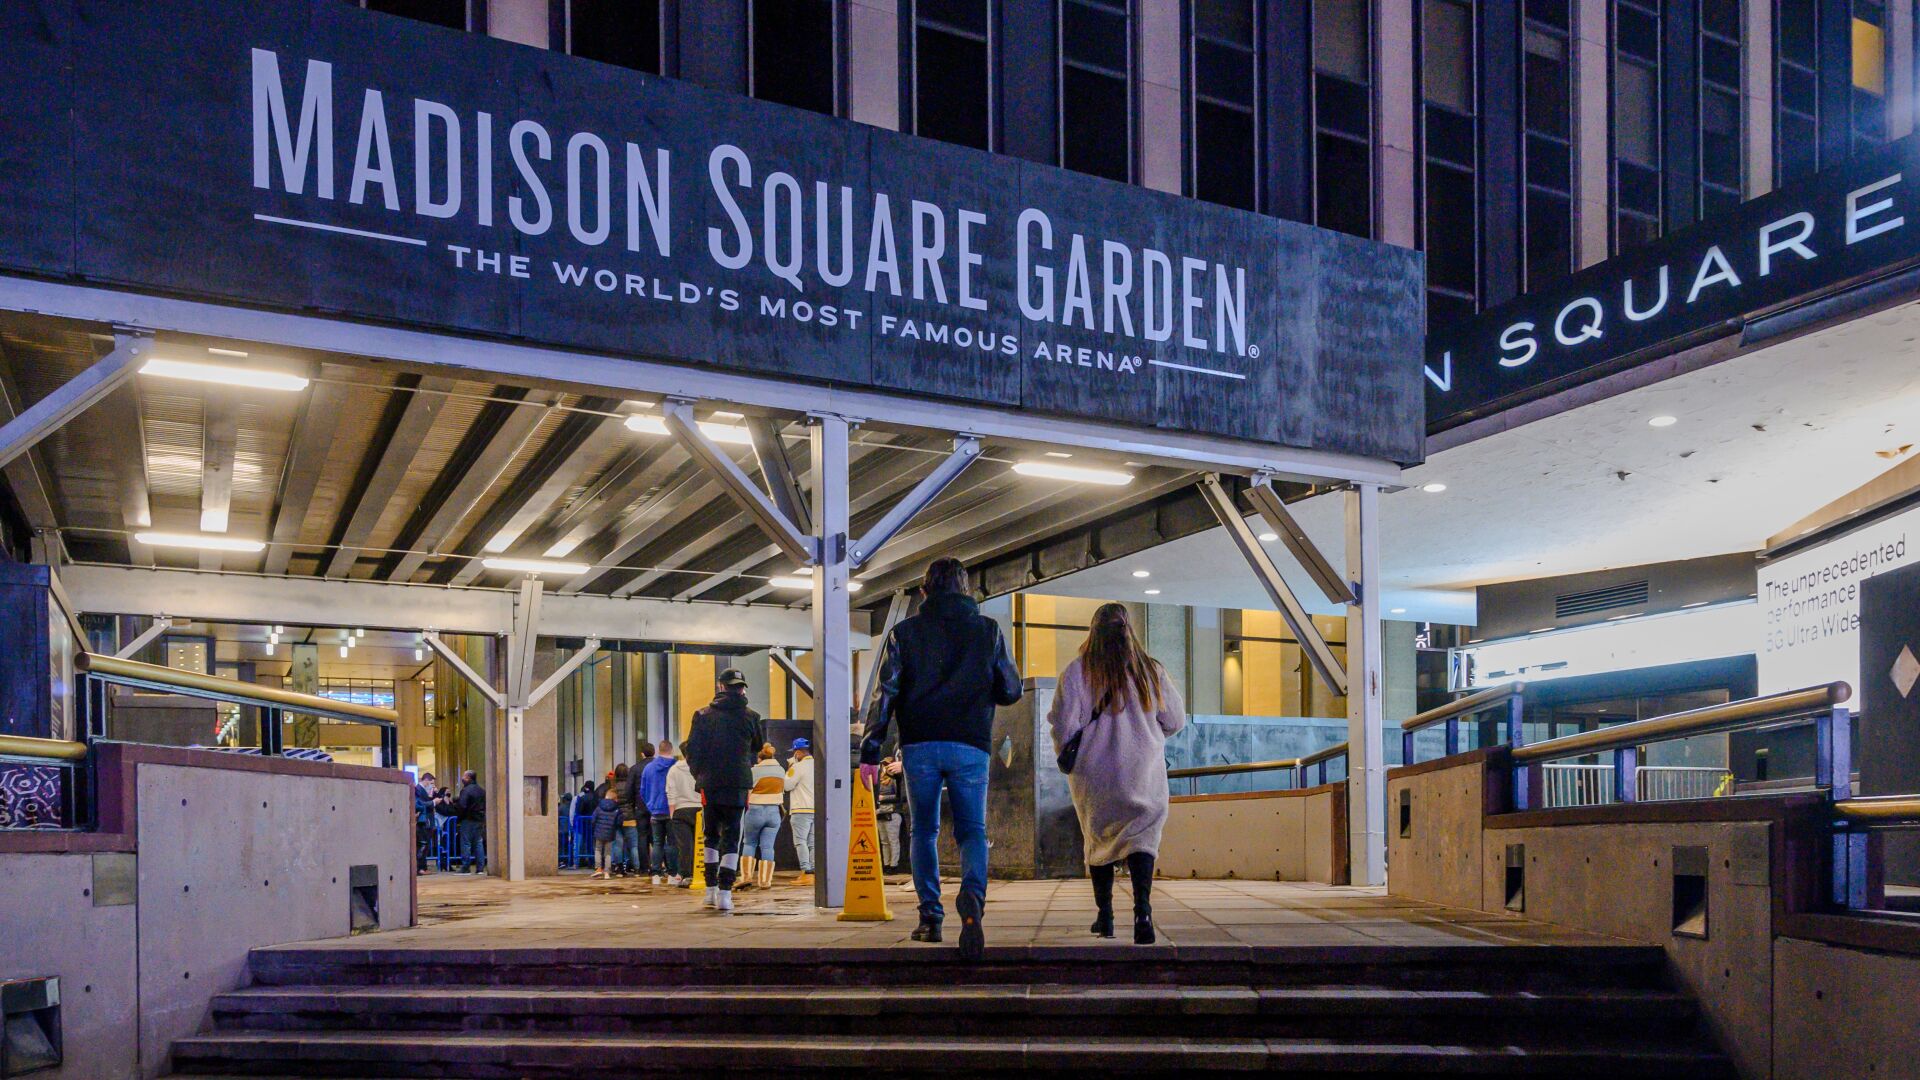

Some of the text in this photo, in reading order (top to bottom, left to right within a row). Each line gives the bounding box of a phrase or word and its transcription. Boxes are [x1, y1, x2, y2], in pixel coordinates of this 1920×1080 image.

[252, 48, 670, 257] MADISON
[708, 145, 987, 310] SQUARE
[448, 244, 530, 279] THE
[552, 261, 740, 311] WORLD'S
[760, 295, 863, 330] MOST
[881, 314, 1018, 356] FAMOUS
[1499, 173, 1904, 367] SQUARE
[1766, 533, 1906, 600] The unprecedented
[1787, 622, 1819, 647] Ultra
